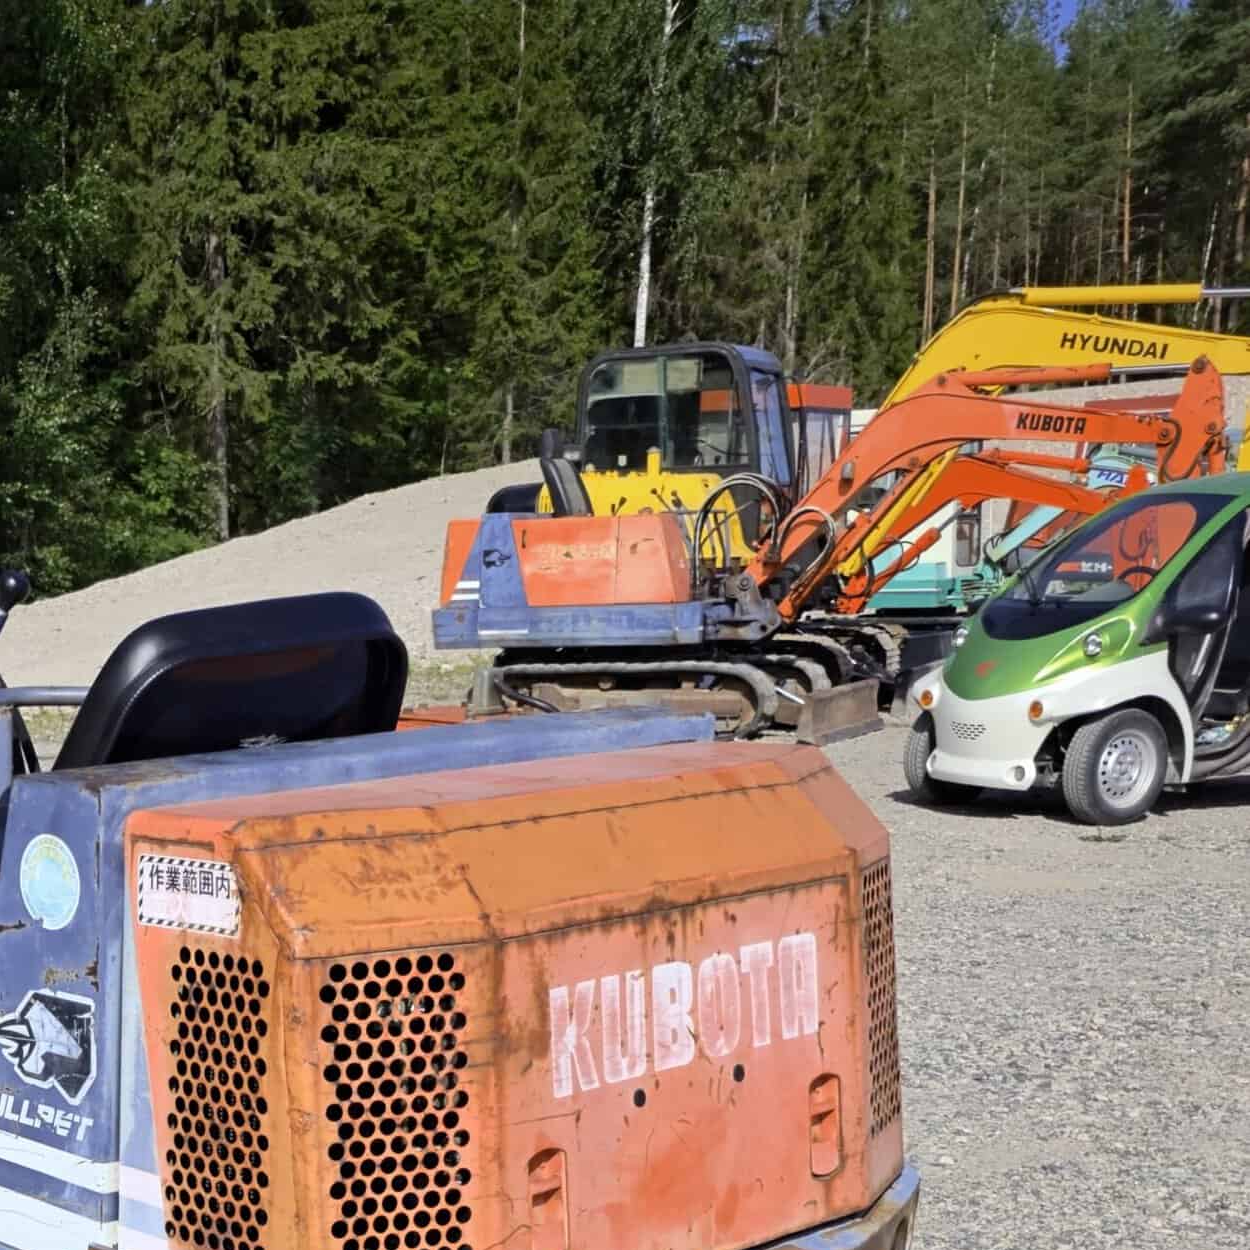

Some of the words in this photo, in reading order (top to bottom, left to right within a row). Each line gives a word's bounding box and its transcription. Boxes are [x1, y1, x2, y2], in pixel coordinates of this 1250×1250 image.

[1060, 332, 1169, 360] HYUNDAI
[1016, 412, 1087, 434] KUBOTA
[149, 863, 230, 899] 作業範囲内
[549, 931, 819, 1099] KUBOTA
